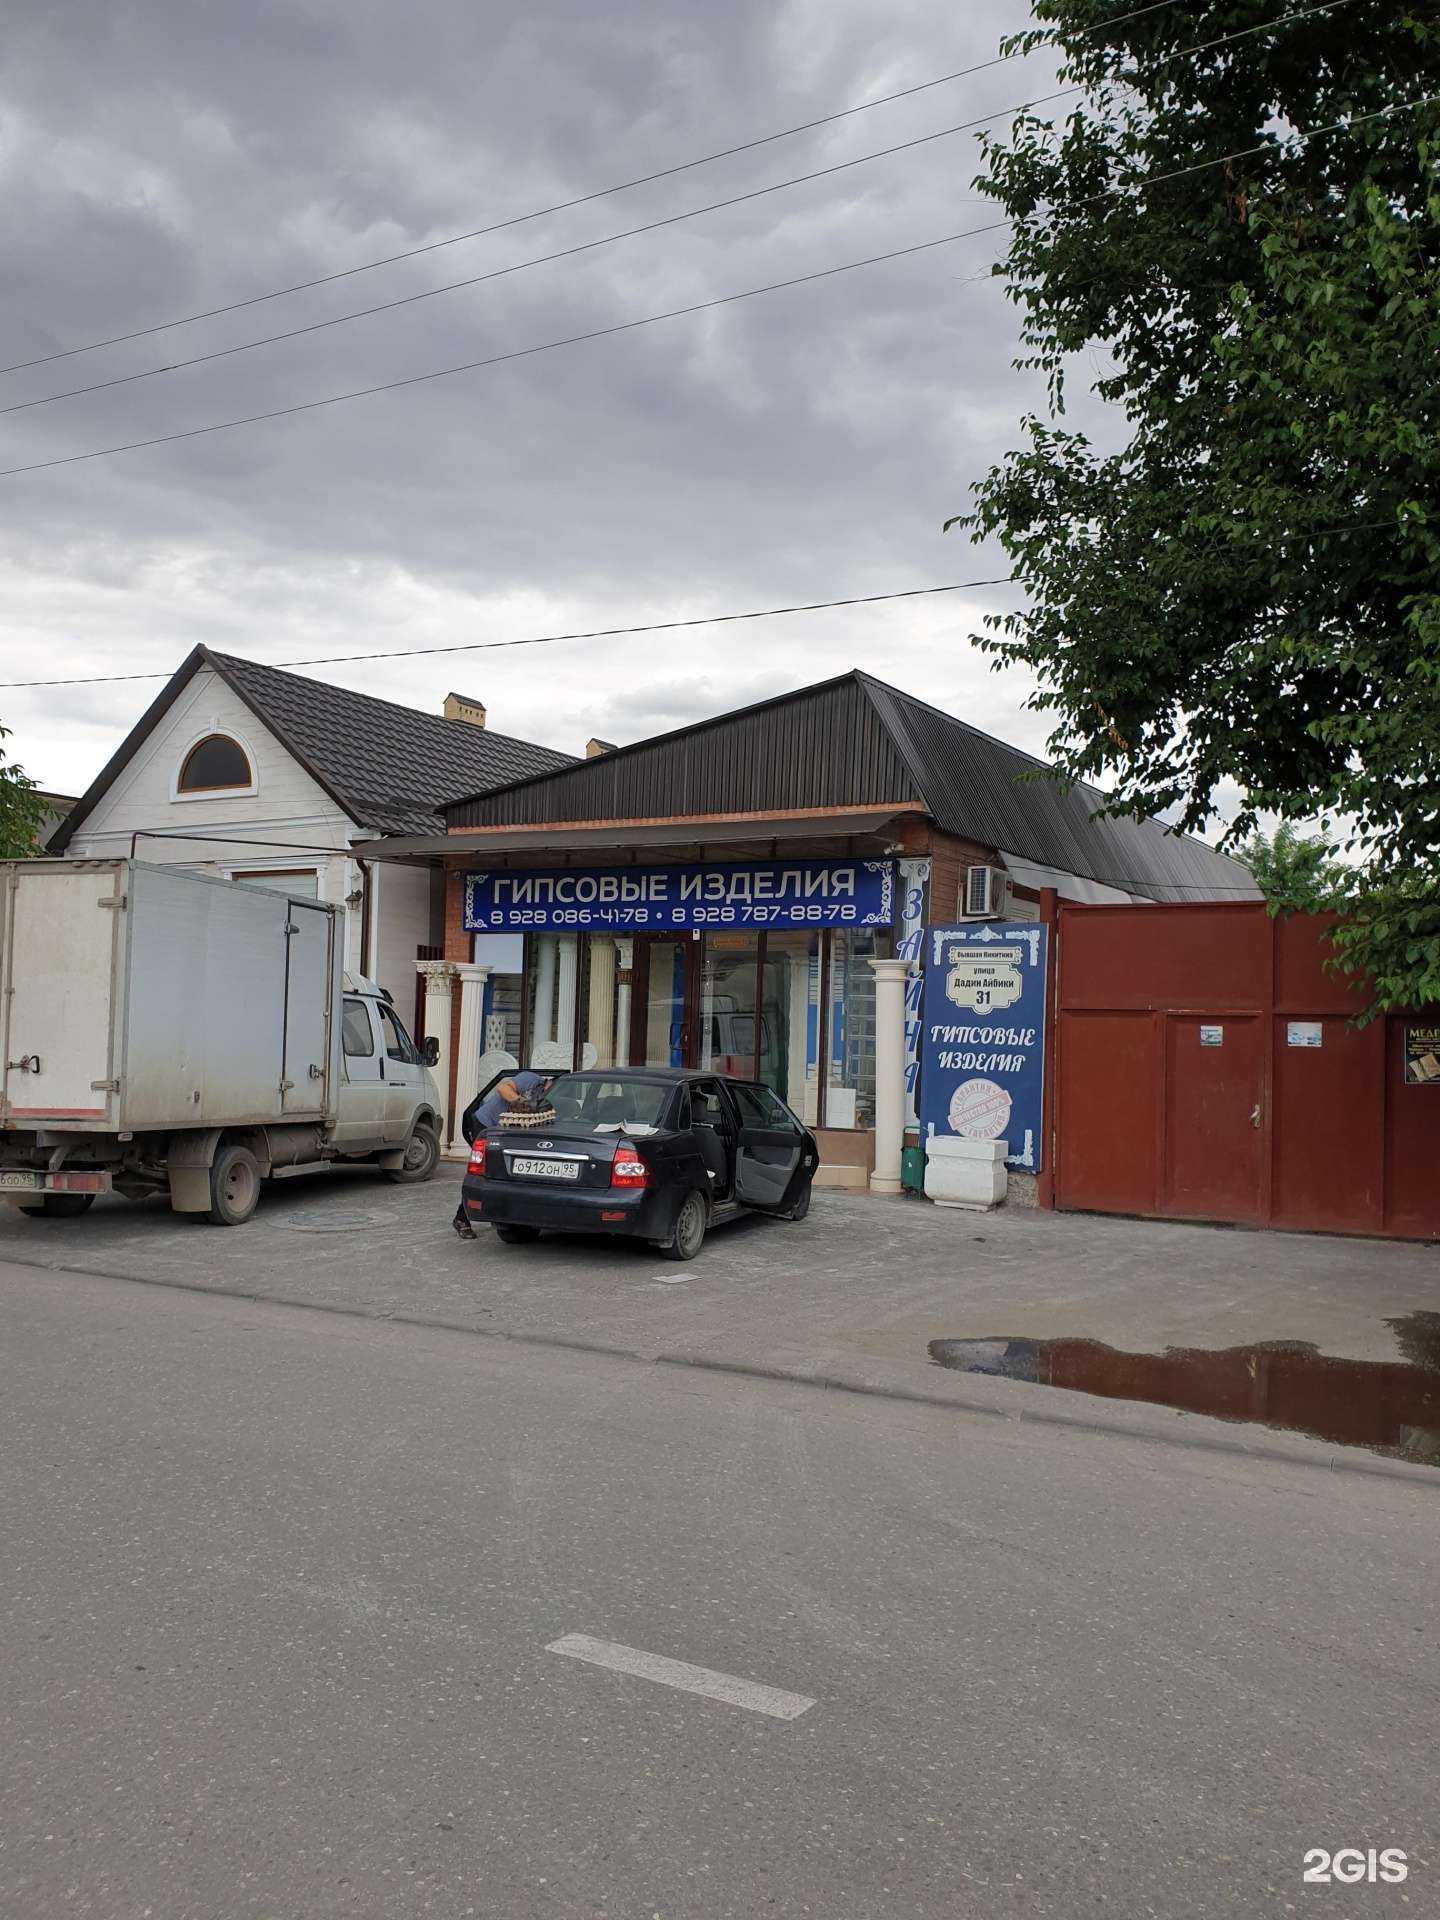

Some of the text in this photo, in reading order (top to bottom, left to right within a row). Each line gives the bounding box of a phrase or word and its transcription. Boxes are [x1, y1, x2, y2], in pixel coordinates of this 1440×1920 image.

[494, 869, 855, 904] ГИПСОВЫЕ ИЗДЕЛИЯ
[490, 904, 856, 924] 8 928 086-41-78 8 928 787-88-78
[973, 967, 996, 976] улица
[954, 978, 1014, 988] Дадин Айбики
[976, 990, 990, 1004] 31
[930, 1025, 1036, 1047] ГИПСОВЫЕ
[938, 1051, 1026, 1073] ИЗДЕЛИЯ
